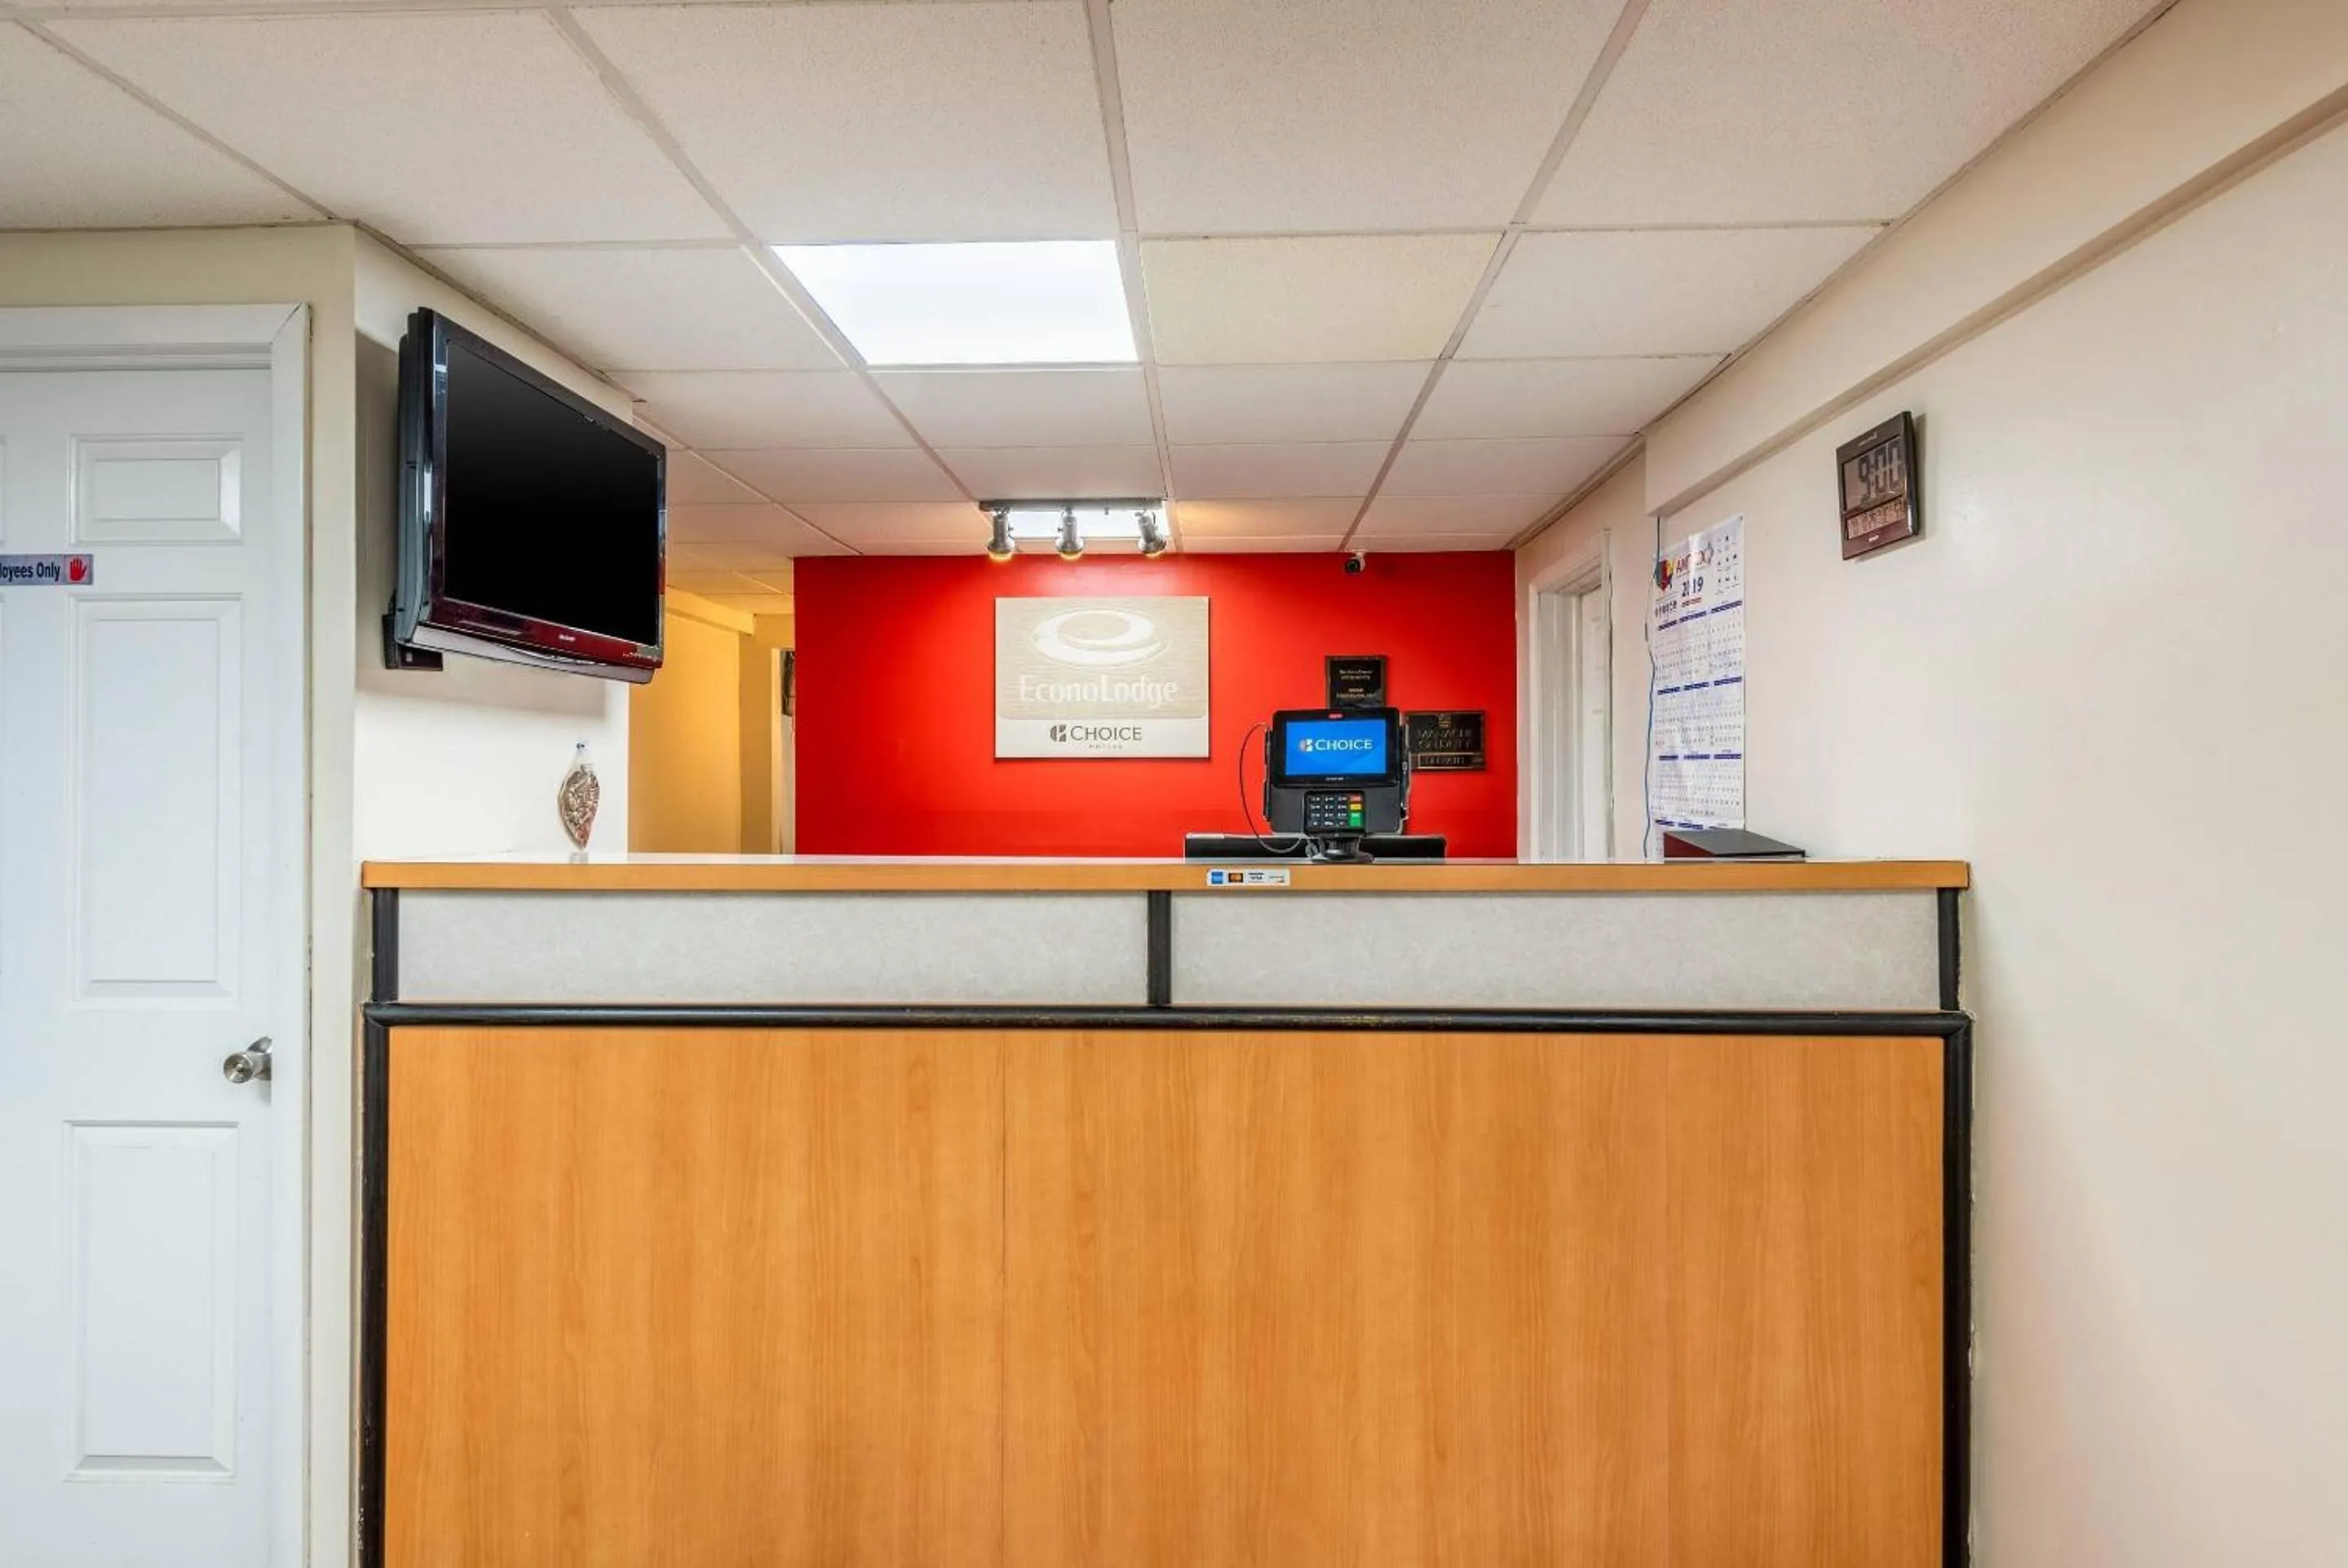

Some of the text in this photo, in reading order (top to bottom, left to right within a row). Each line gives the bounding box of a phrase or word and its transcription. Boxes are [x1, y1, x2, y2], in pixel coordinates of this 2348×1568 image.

[36, 562, 60, 581] Only
[1070, 725, 1142, 741] CHOICE
[1315, 739, 1373, 751] CHOICE
